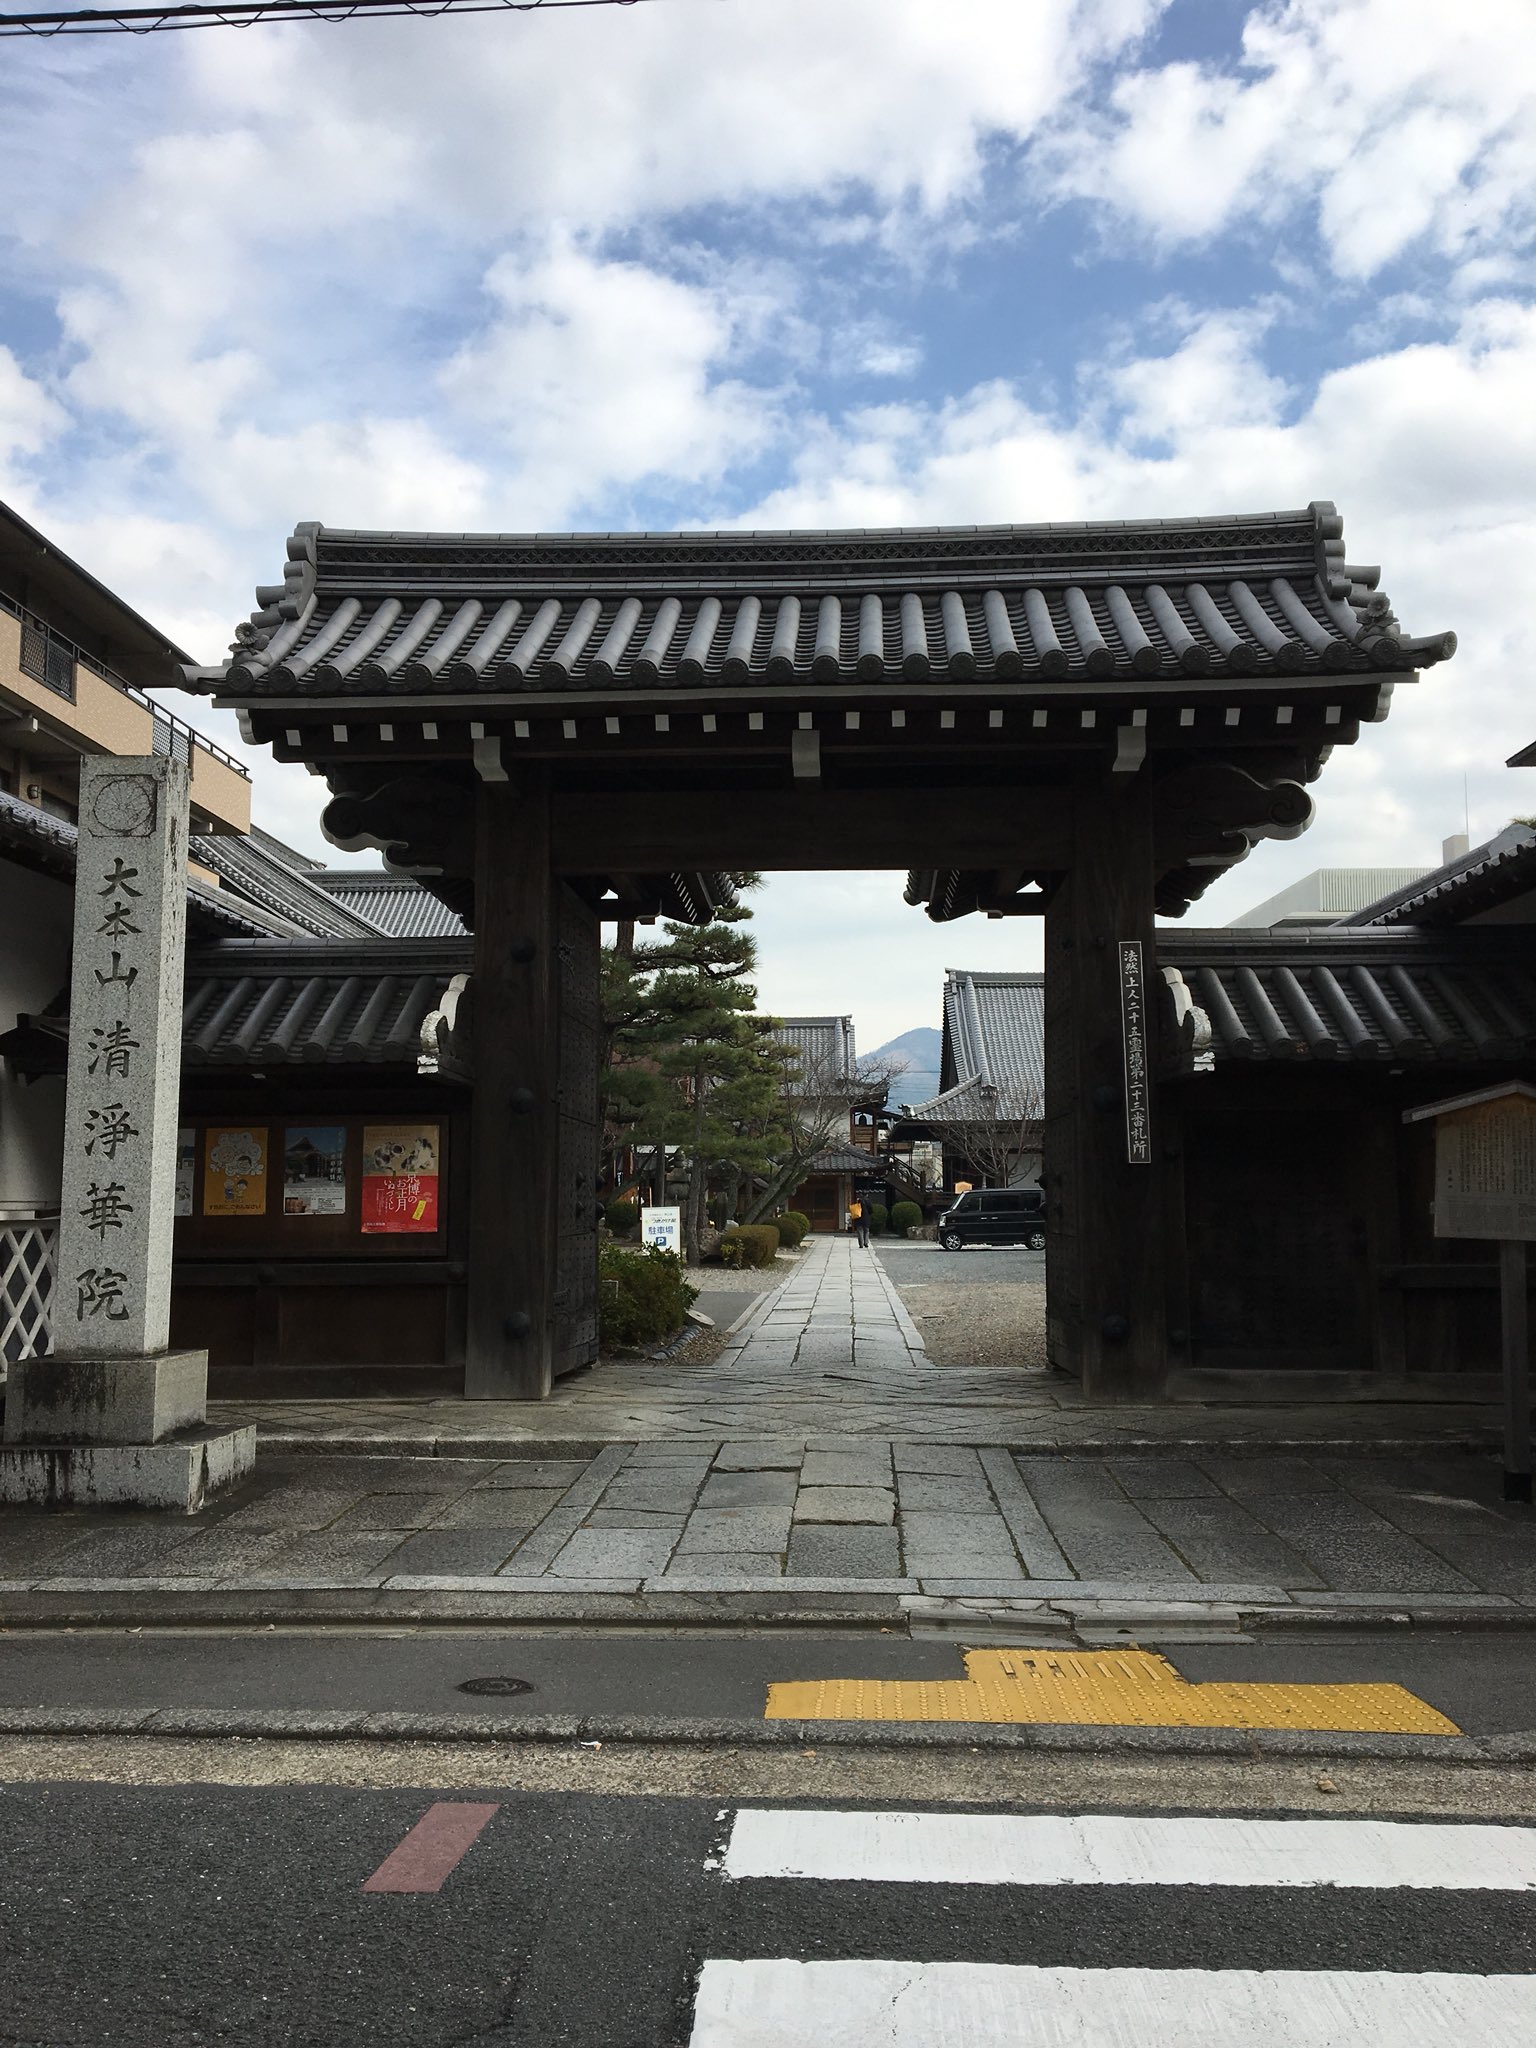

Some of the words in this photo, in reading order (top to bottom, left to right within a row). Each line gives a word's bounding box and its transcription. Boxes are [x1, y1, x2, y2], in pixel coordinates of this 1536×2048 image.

[383, 1179, 396, 1211] いぬづくし
[395, 1179, 408, 1213] お正月
[406, 1171, 420, 1204] 京博の
[648, 1226, 673, 1234] 駐車場
